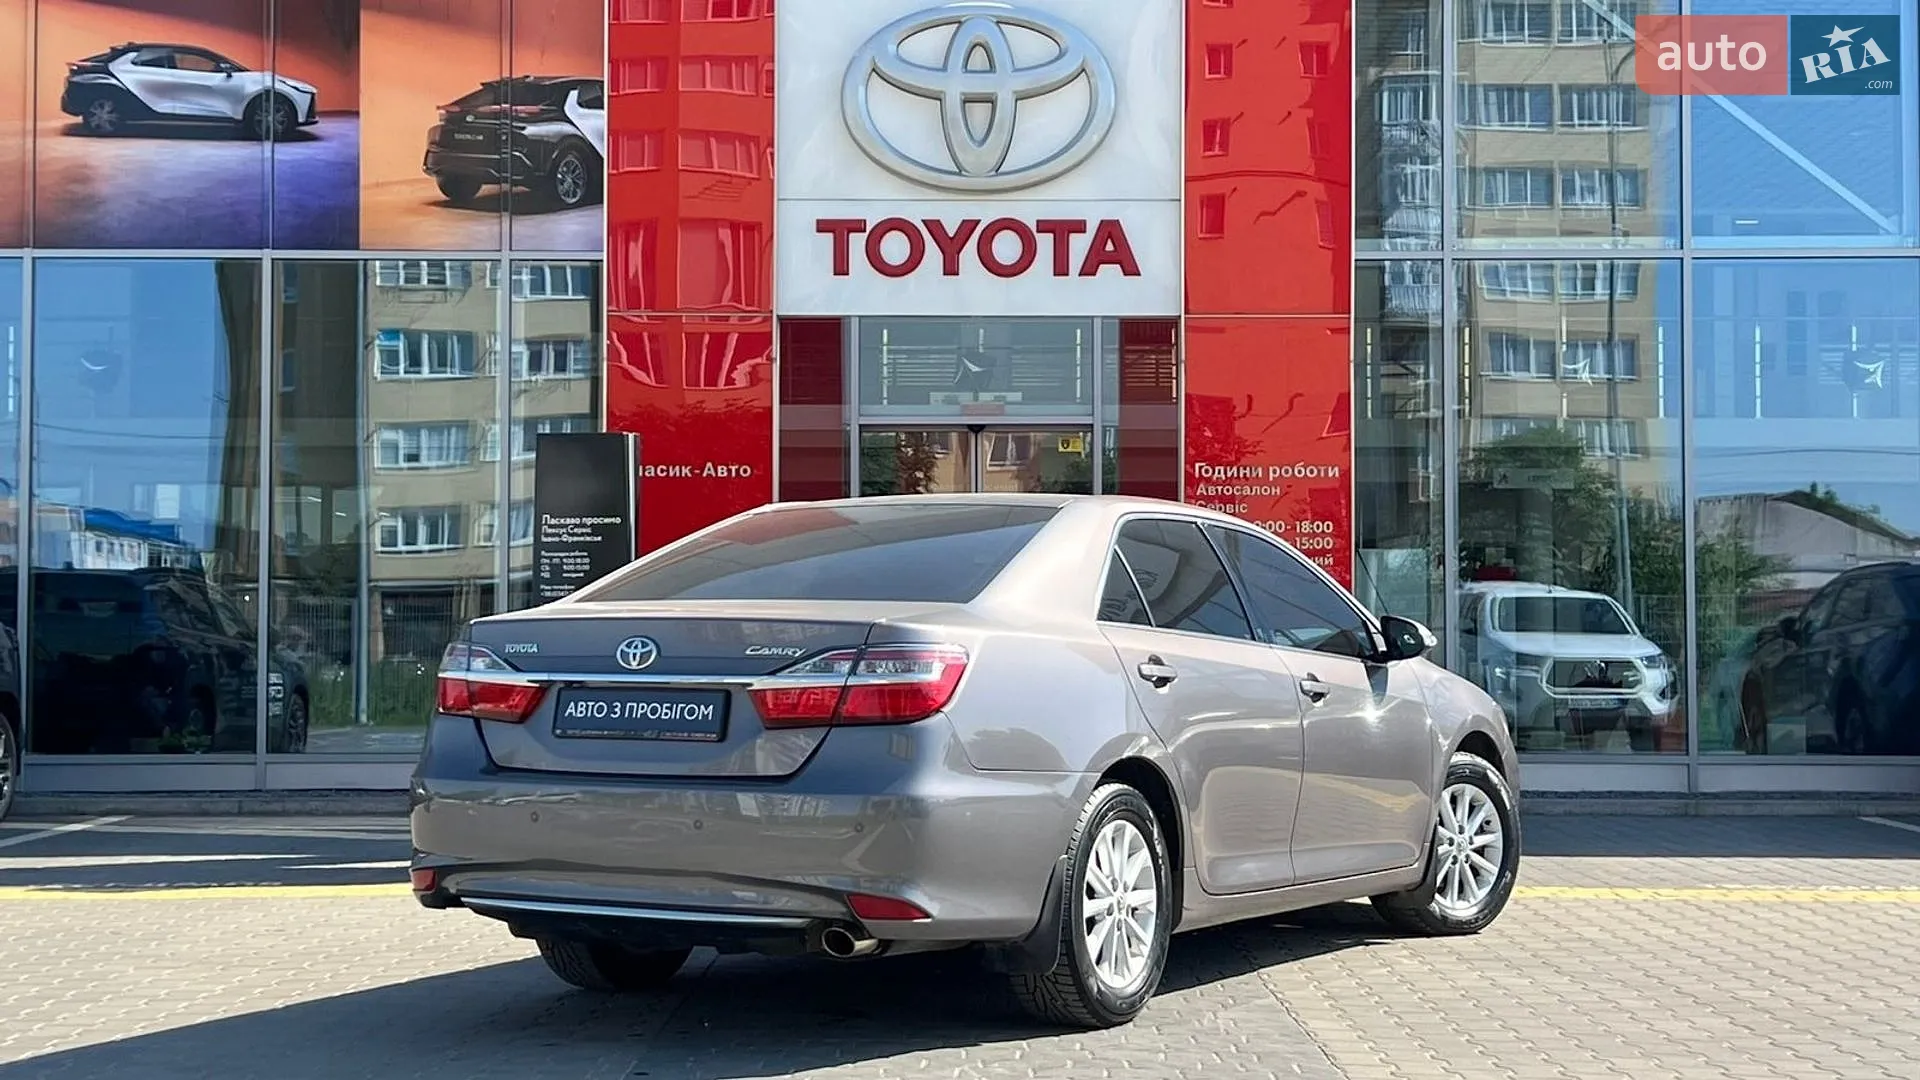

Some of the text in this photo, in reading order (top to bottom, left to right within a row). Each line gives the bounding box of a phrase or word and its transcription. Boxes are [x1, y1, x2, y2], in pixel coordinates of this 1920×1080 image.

[816, 217, 1141, 278] TOYOTA
[1194, 462, 1340, 480] Години роботи
[1196, 483, 1280, 496] Автосалон
[1296, 521, 1333, 533] 18:00
[1296, 537, 1333, 550] 15:00
[504, 643, 539, 654] TOYOTA
[744, 645, 807, 658] CAMRY
[565, 701, 607, 718] АВТО
[625, 703, 714, 720] ПРОБІГОМ
